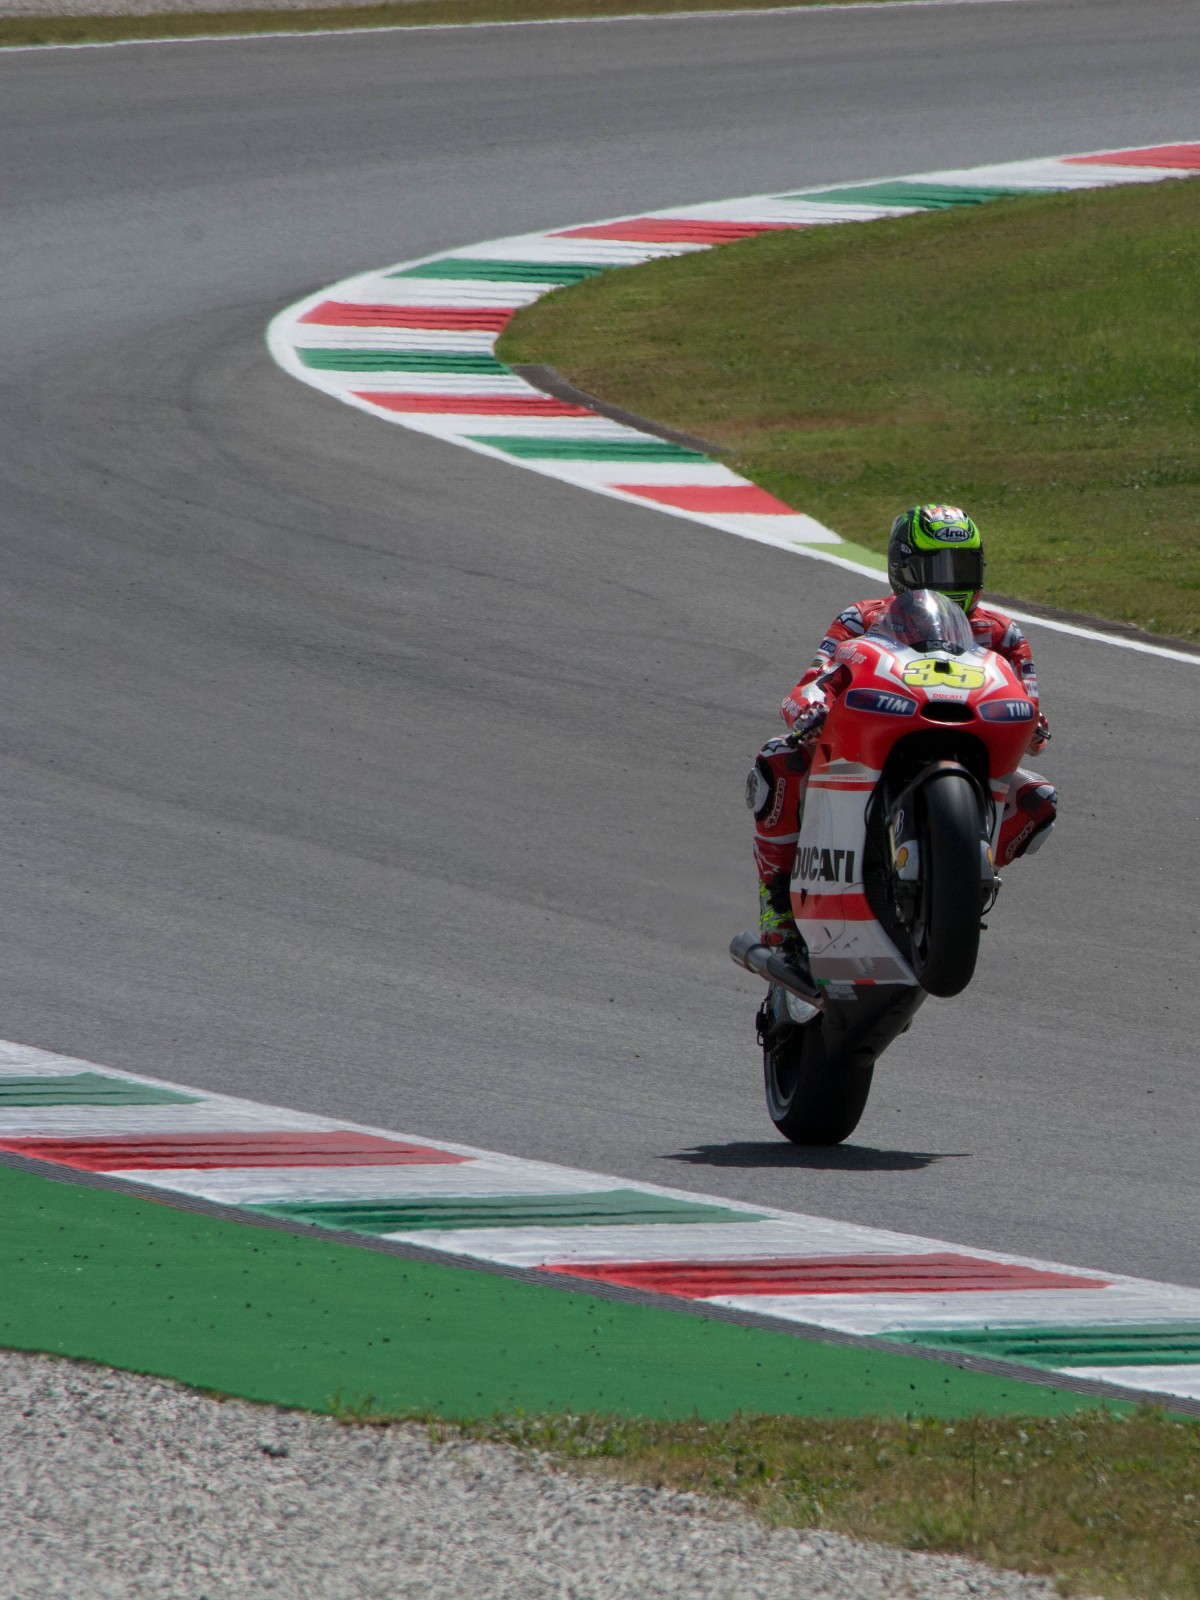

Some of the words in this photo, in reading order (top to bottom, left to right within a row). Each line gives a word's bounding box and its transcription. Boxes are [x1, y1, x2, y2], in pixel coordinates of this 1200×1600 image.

[935, 527, 967, 539] Arai
[901, 658, 985, 689] 35
[876, 695, 909, 712] TIM
[1006, 702, 1031, 717] TIM
[792, 846, 855, 884] DUCATI
